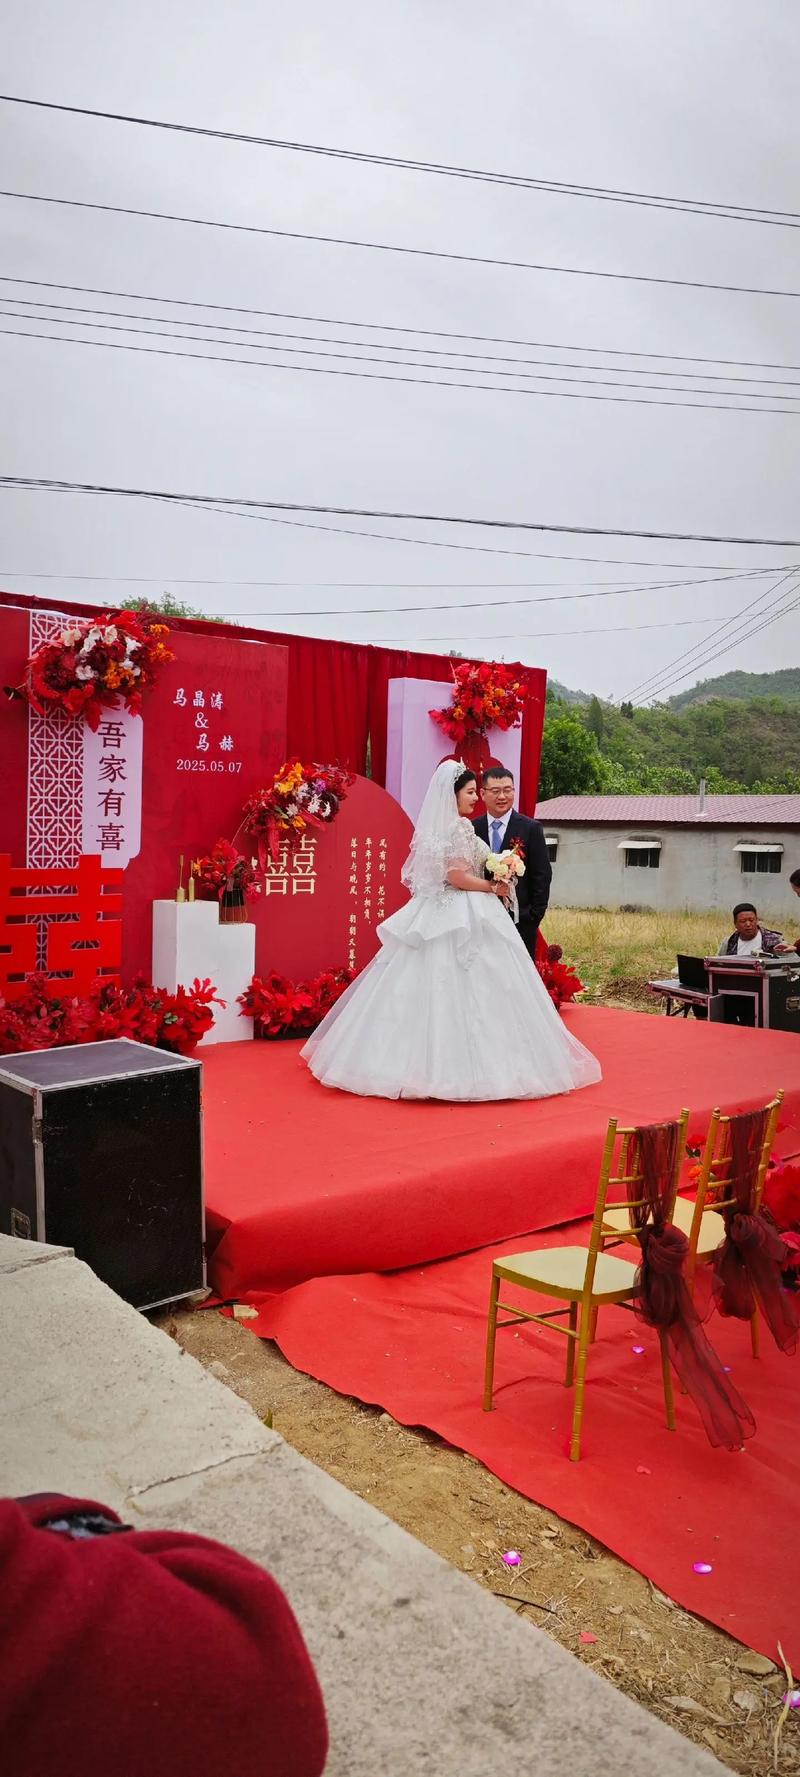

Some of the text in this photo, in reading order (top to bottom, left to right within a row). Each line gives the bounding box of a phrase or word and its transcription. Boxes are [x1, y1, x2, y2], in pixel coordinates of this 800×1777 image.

[173, 688, 223, 710] 马晶涛
[194, 711, 209, 729] &
[176, 758, 243, 773] 2025.05.07
[96, 721, 127, 851] 吾家有喜
